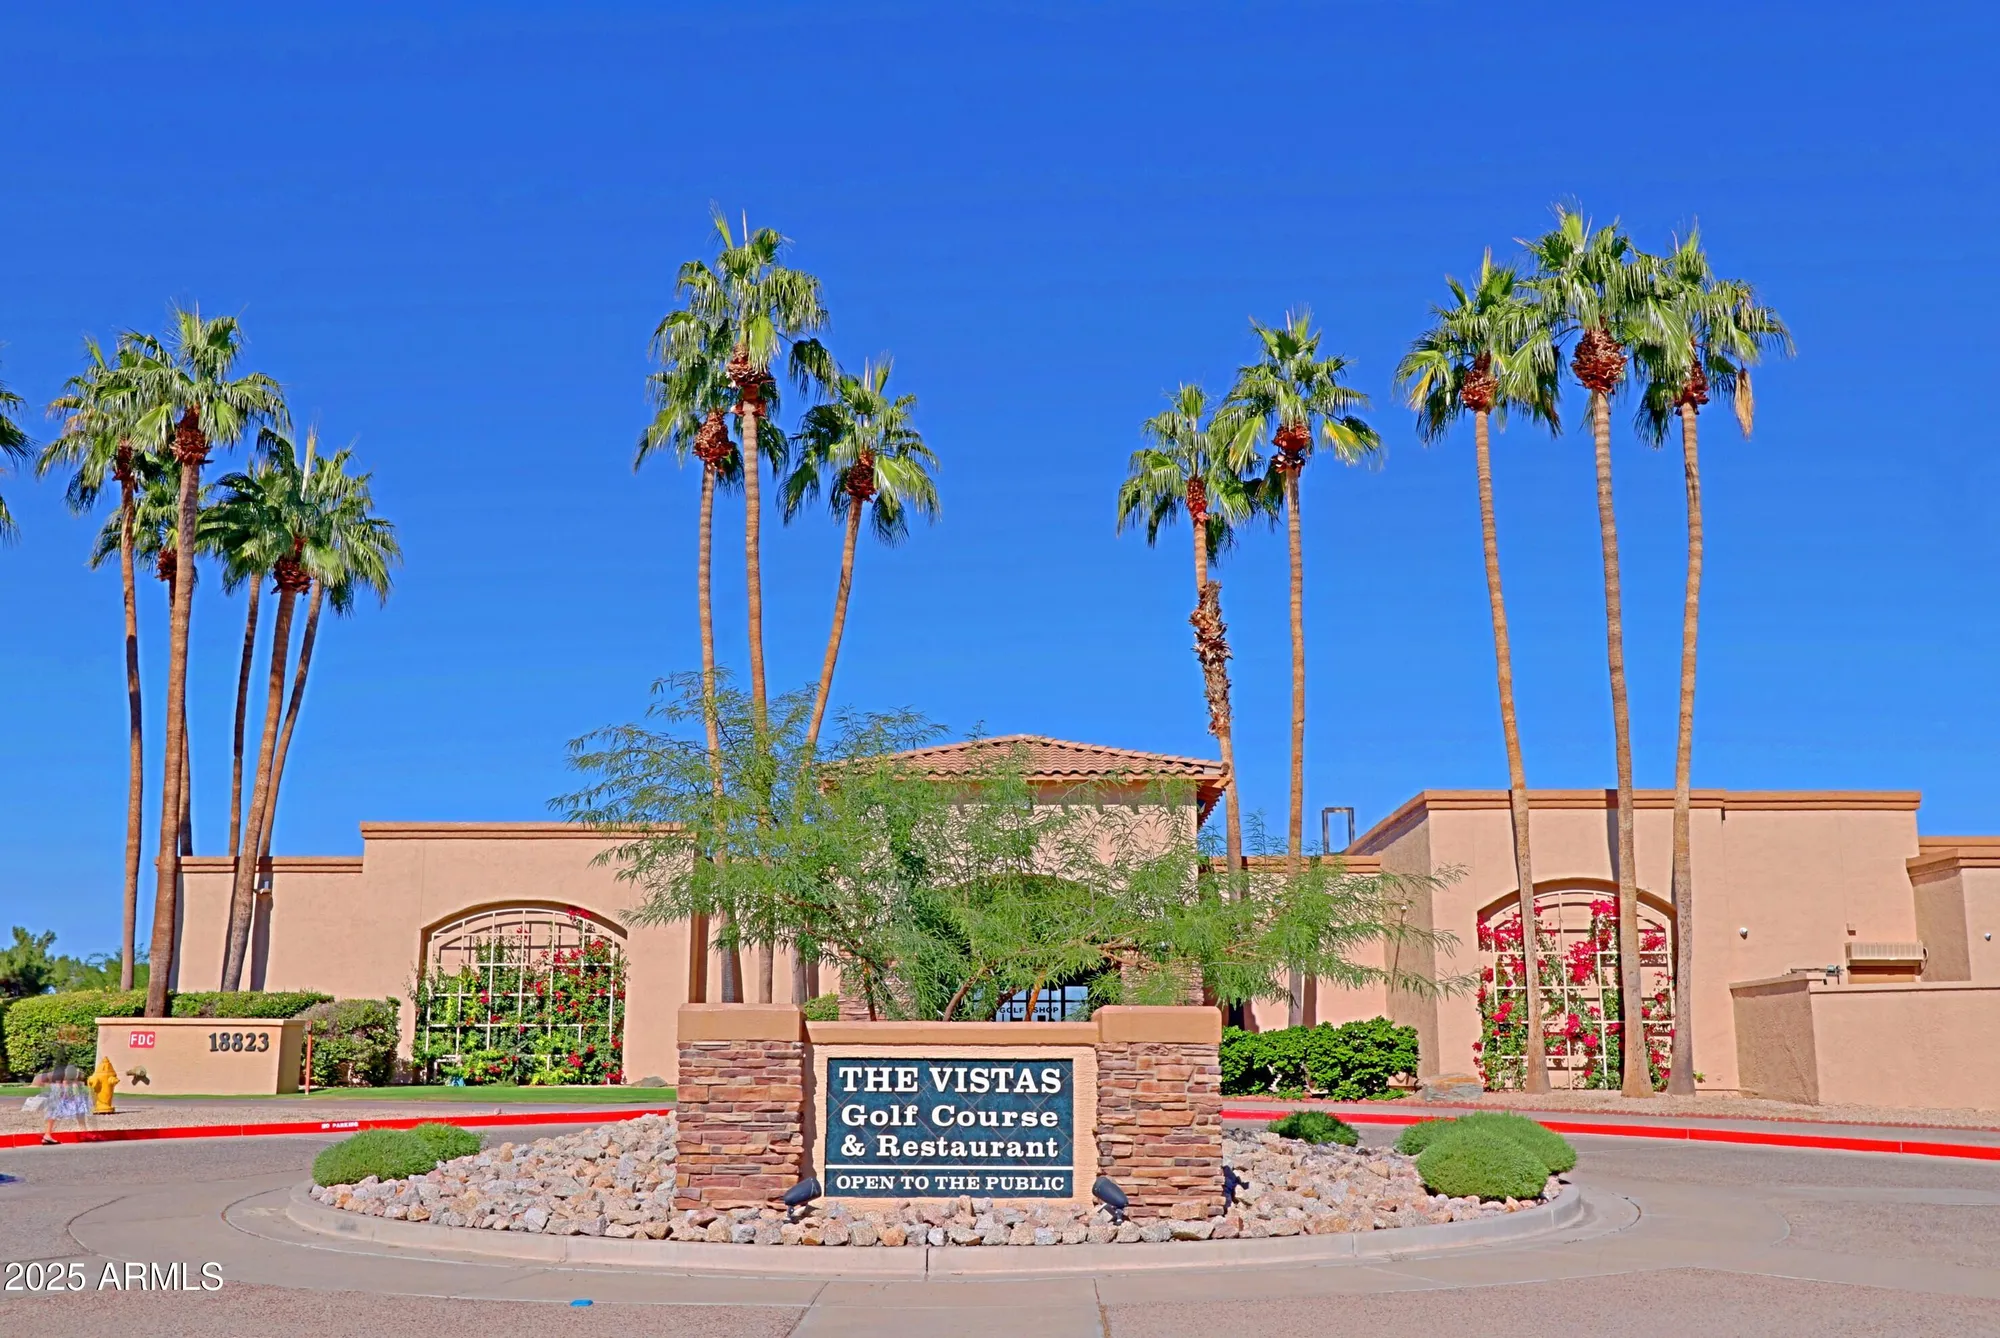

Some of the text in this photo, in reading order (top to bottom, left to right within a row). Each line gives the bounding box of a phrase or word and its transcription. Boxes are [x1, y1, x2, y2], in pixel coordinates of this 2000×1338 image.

[1000, 1006, 1059, 1014] GOLF SHOP
[130, 1033, 154, 1046] FDC
[208, 1032, 270, 1053] 18823
[838, 1067, 1062, 1094] THE VISTAS
[841, 1104, 1059, 1128] Golf Course
[841, 1134, 1059, 1159] & Restaurant
[836, 1175, 1065, 1192] OPEN TO THE PUBLIC
